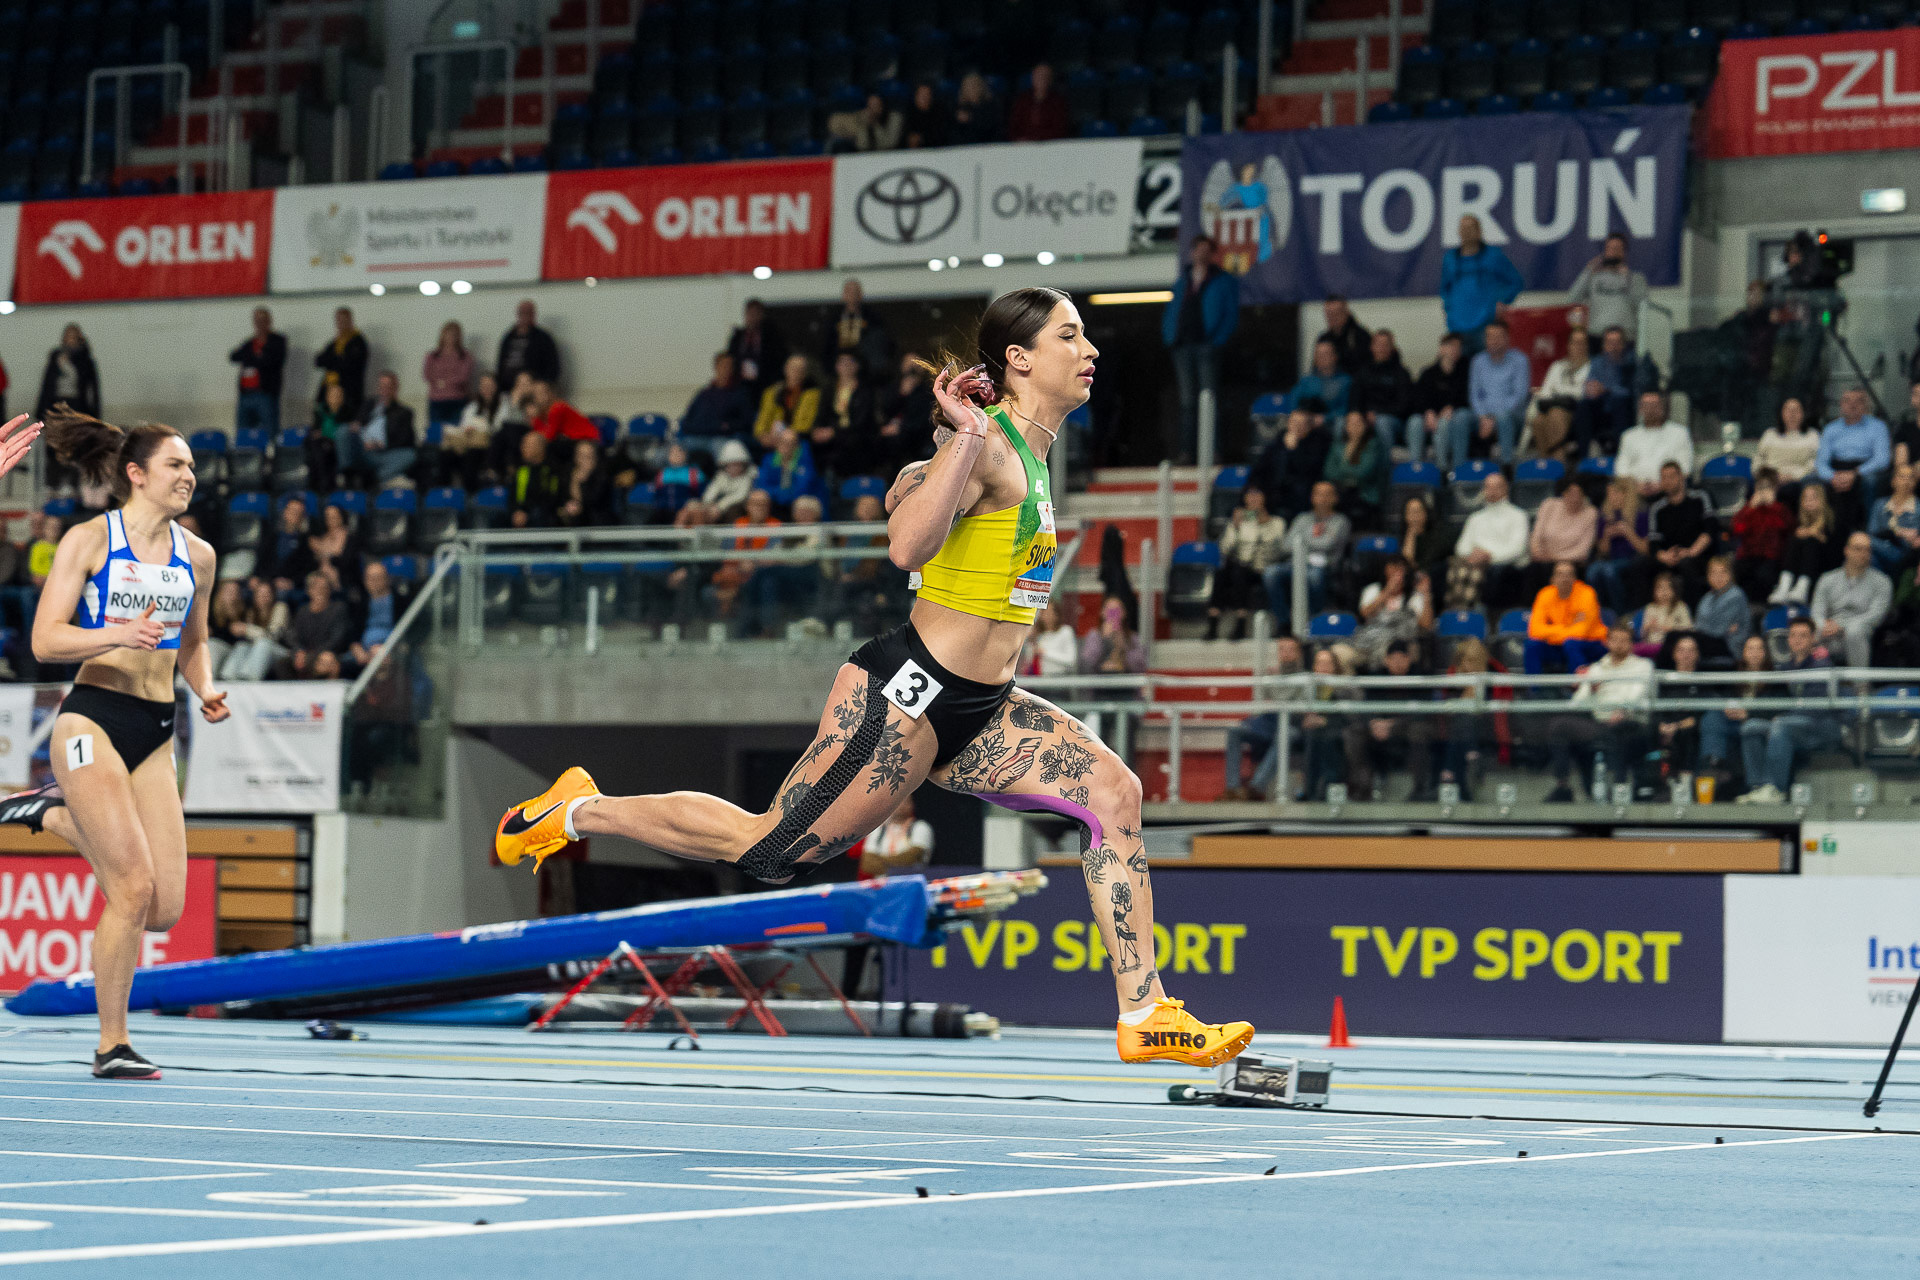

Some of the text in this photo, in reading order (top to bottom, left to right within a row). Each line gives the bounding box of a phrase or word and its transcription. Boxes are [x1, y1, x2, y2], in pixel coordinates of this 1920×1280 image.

[1756, 48, 1920, 115] PZL
[992, 181, 1117, 219] Okęcie
[1301, 128, 1657, 255] TORUŃ
[654, 193, 810, 240] ORLEN
[115, 223, 255, 266] ORLEN
[161, 570, 179, 583] 89
[110, 592, 188, 612] ROMASZKO
[895, 672, 929, 707] 3
[73, 739, 84, 764] 1
[0, 929, 170, 977] MOE
[1331, 926, 1682, 984] TVP SPORT
[1135, 1031, 1207, 1049] NITRO
